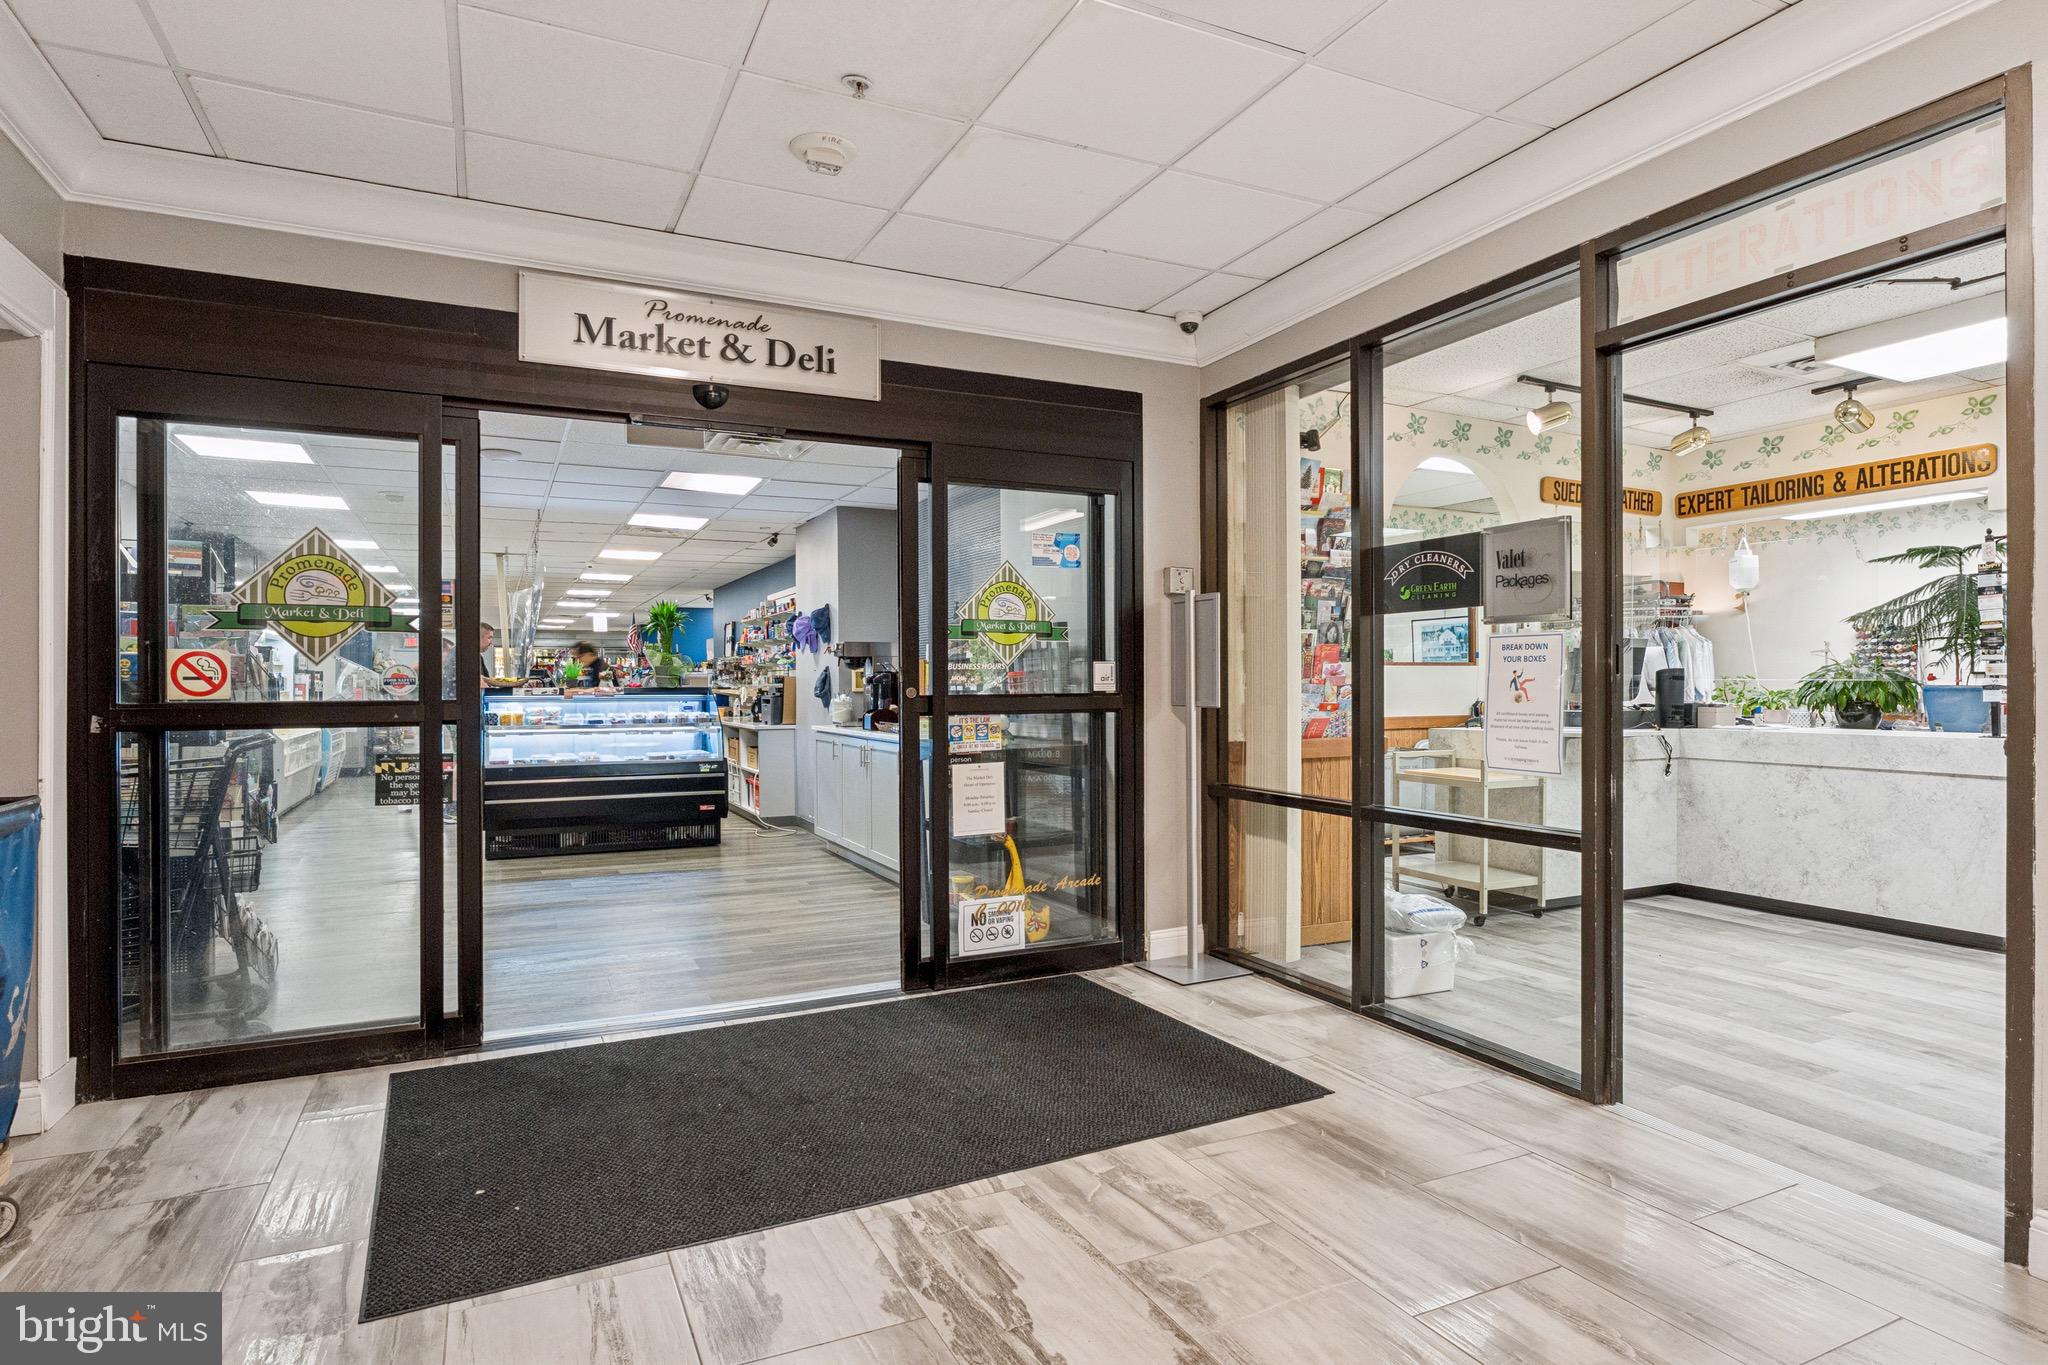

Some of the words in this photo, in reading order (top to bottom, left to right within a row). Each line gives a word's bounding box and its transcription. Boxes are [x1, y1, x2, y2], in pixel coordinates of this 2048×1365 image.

[1627, 143, 1990, 306] ALTERATIONS
[645, 299, 772, 333] Promenade
[573, 312, 711, 359] Market
[720, 333, 756, 364] &
[765, 337, 838, 375] Deli
[1677, 490, 1734, 516] EXPERT
[1740, 474, 1824, 506] TAILORING
[1833, 470, 1848, 492] &
[1855, 448, 1991, 490] ALTERATIONS
[1553, 481, 1582, 503] SUED
[1622, 489, 1654, 513] ATHER
[1391, 562, 1411, 579] DRY
[1414, 553, 1466, 573] CLEANERS
[1496, 549, 1526, 569] Valet
[270, 557, 359, 592] Promenade
[1495, 573, 1550, 588] Packages
[1410, 583, 1432, 593] GREEN
[1433, 581, 1457, 592] EARTH
[980, 584, 1033, 610] Promenade
[1411, 592, 1457, 600] CLEANING
[264, 606, 314, 619] Market
[319, 608, 330, 619] &
[333, 607, 364, 620] Deli
[976, 621, 1007, 631] Market
[1008, 622, 1016, 631] &
[1018, 622, 1036, 632] Deli
[1501, 643, 1522, 651] BREAK
[1525, 642, 1548, 650] DOWN
[948, 662, 981, 670] BUSINESS
[981, 662, 1006, 670] HOURS
[1503, 655, 1521, 663] YOUR
[380, 797, 411, 805] tobacco
[975, 880, 1048, 898] Proade
[1054, 873, 1101, 891] Arcade
[970, 912, 987, 927] NO
[996, 916, 1014, 924] VAPING
